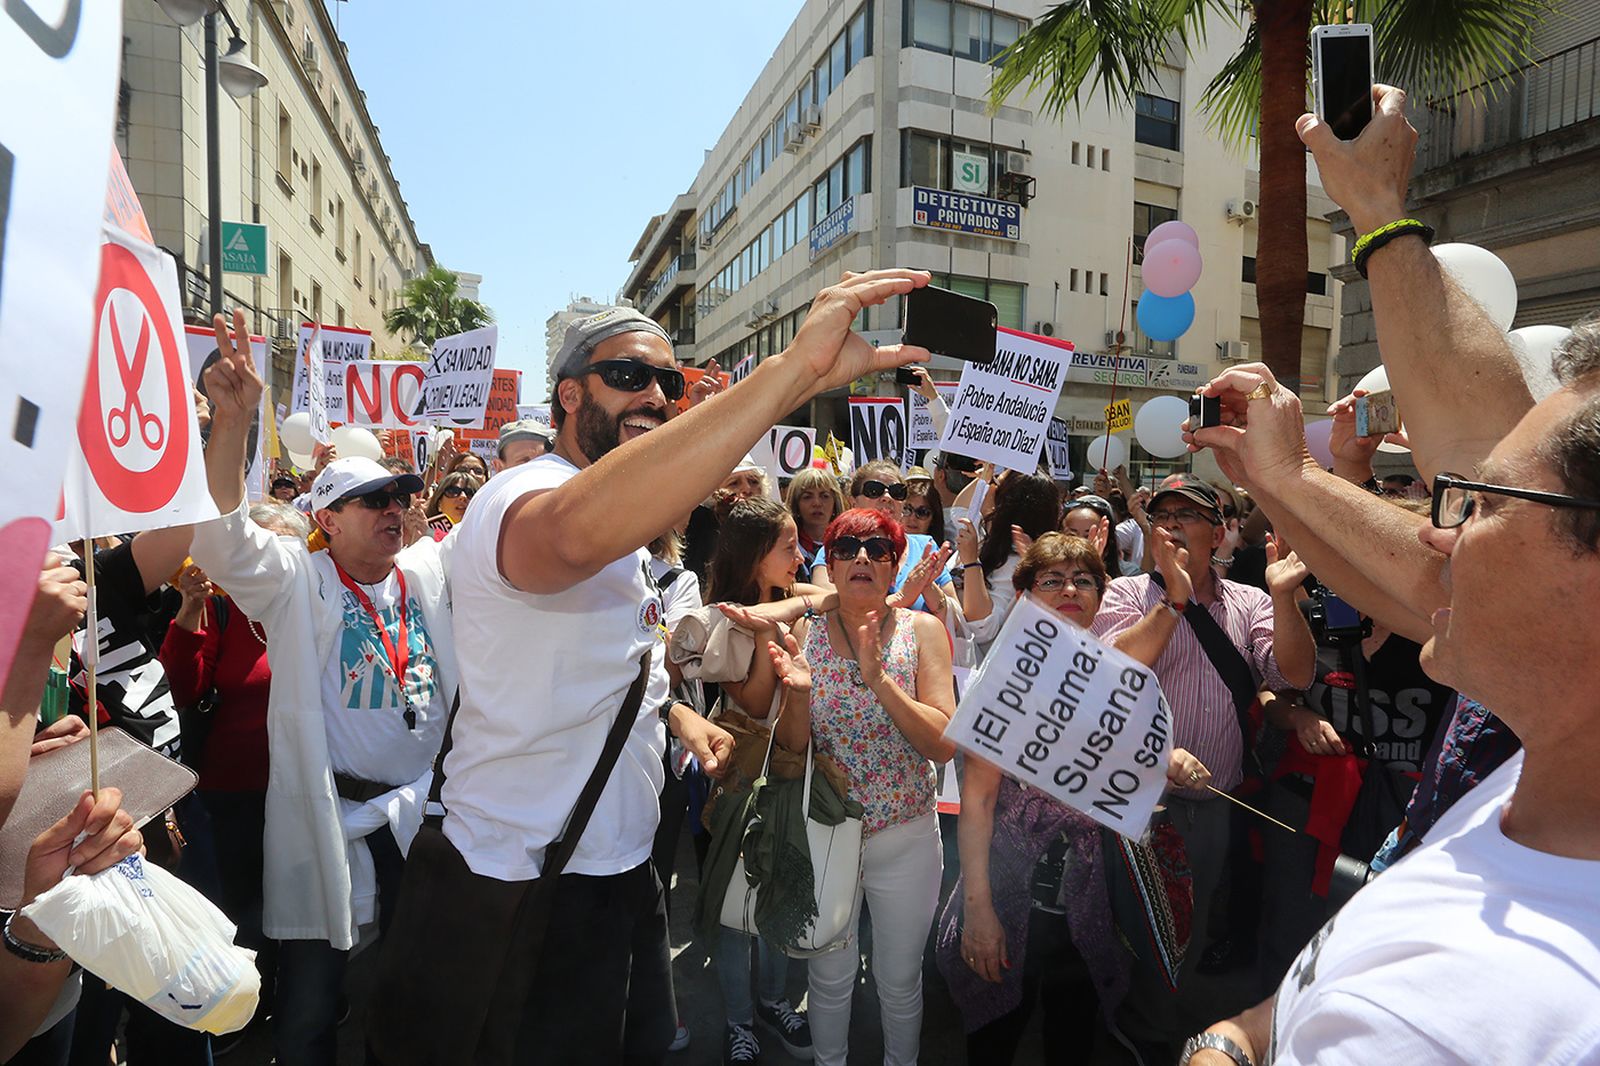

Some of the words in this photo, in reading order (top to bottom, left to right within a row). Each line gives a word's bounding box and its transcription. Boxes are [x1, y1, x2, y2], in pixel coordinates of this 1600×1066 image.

[811, 200, 853, 242] DETECTIVES
[918, 190, 1016, 218] DETECTIVES
[938, 209, 999, 230] PRIVADOS
[1011, 353, 1031, 381] NO
[1071, 353, 1145, 370] REVENTIVA
[1094, 371, 1145, 385] SEGUROS
[958, 384, 994, 410] ¡Pobre
[993, 391, 1047, 423] Andalucía
[770, 429, 811, 474] O
[852, 404, 905, 468] NO
[948, 419, 961, 441] y
[958, 416, 990, 444] España
[993, 429, 1012, 448] con
[1011, 428, 1040, 455] Díaz!
[972, 707, 1010, 755] ¡El
[996, 619, 1059, 715] pueblo
[1016, 641, 1103, 775] reclama:
[1054, 666, 1148, 794] Susana
[1092, 769, 1140, 820] NO
